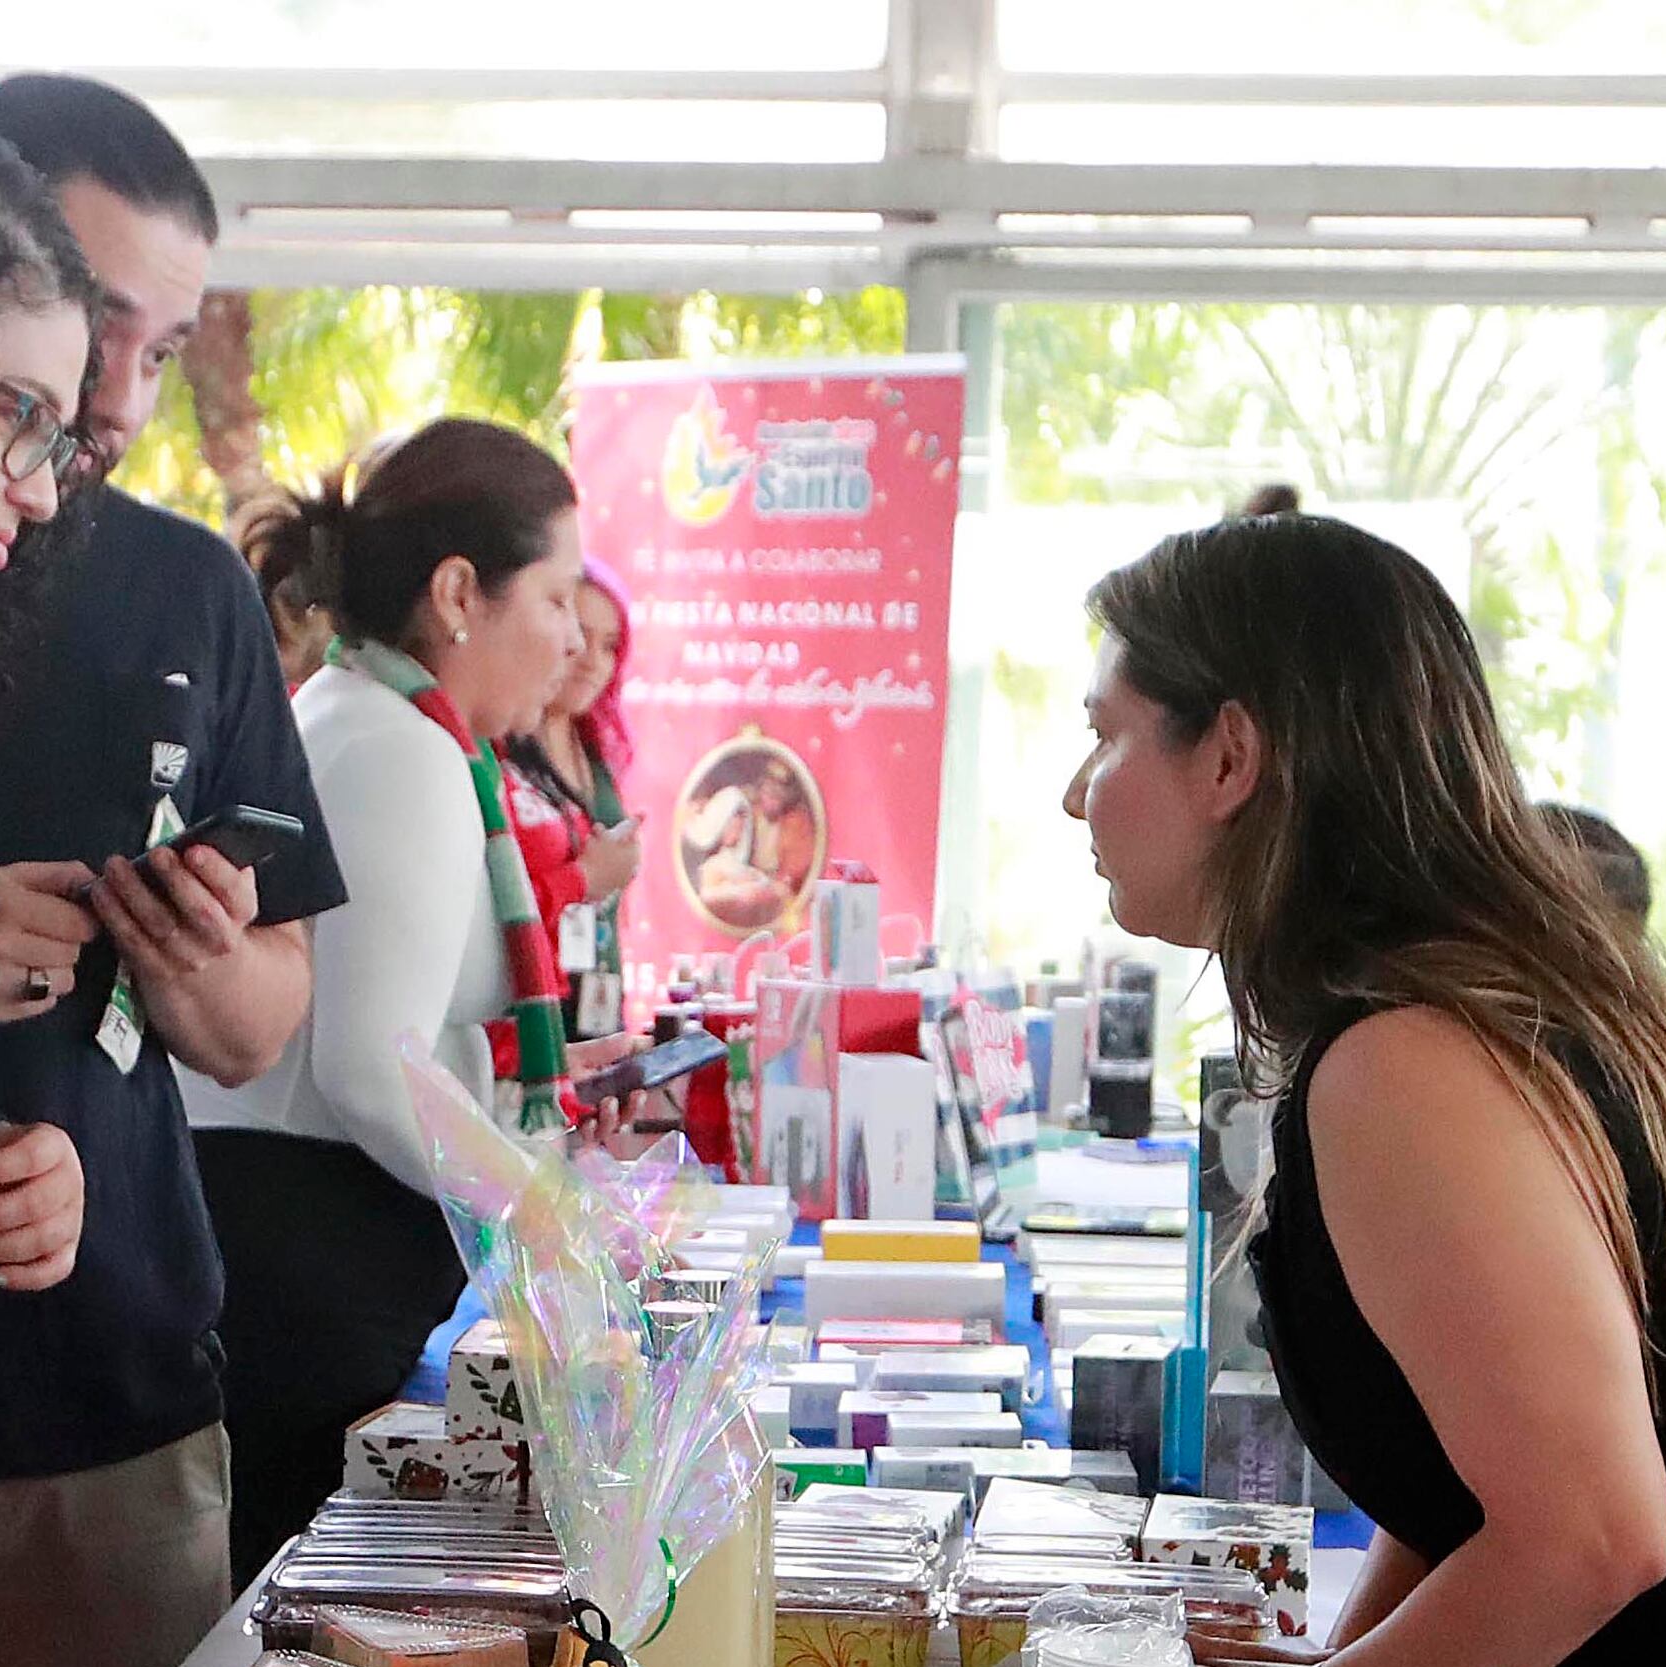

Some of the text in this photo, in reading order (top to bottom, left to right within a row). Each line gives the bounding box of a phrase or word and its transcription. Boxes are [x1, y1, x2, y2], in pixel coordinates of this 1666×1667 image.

[756, 464, 869, 511] Santo
[736, 601, 876, 629] NACIONAL
[882, 601, 919, 630] DE
[683, 639, 801, 668] NAVIDAD
